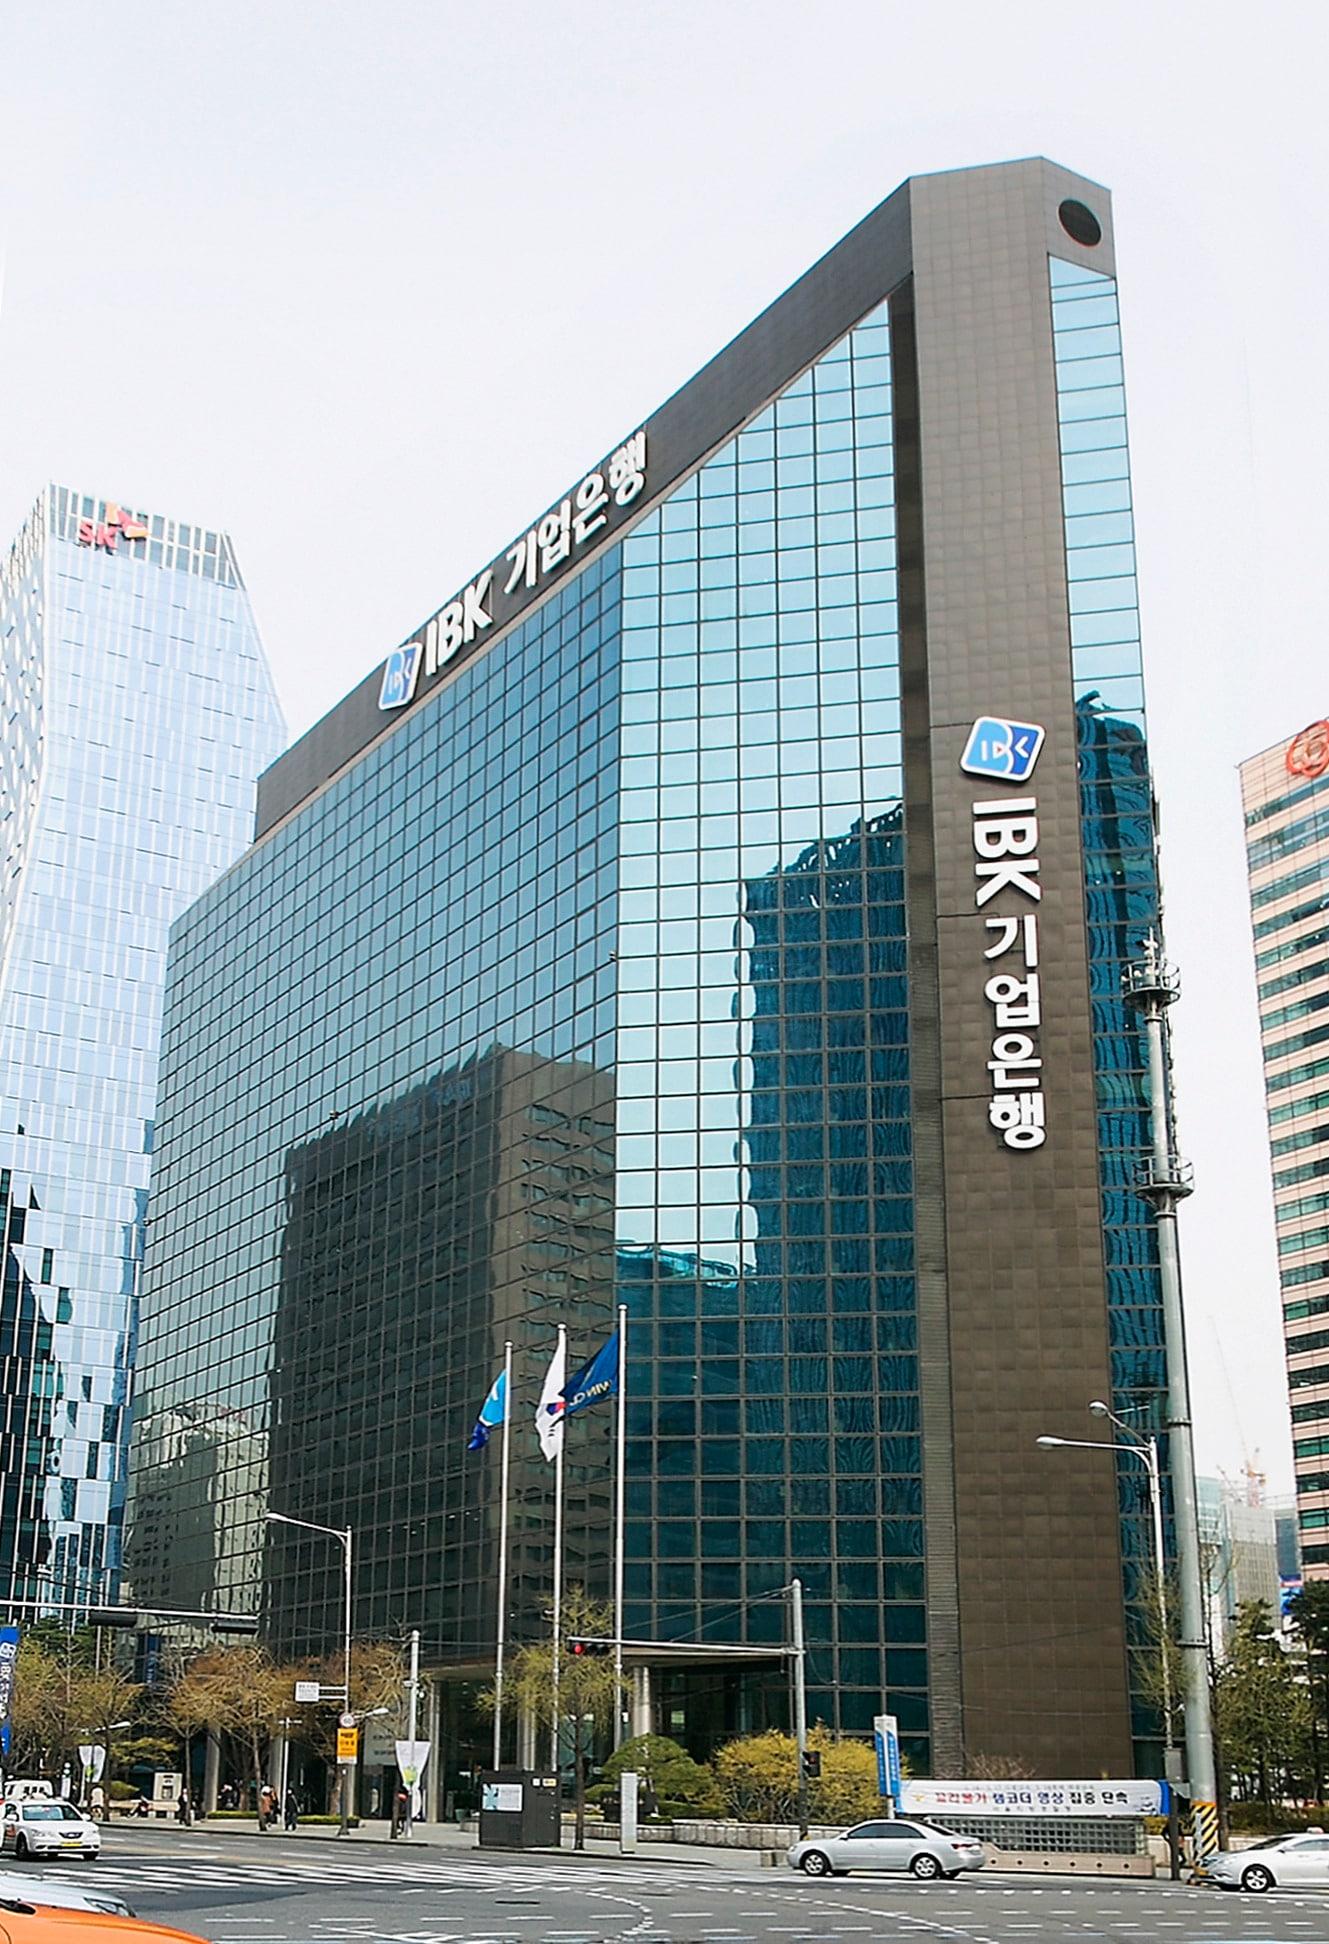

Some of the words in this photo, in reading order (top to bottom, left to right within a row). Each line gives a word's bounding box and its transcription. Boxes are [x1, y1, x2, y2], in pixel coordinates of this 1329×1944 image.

[79, 521, 119, 549] SK
[425, 570, 494, 676] IBK
[504, 431, 647, 594] 기업은행
[973, 797, 1041, 907] IBK
[984, 914, 1046, 1149] 기업은행
[992, 1791, 1032, 1805] 캠코더
[1037, 1791, 1065, 1805] 영상
[1070, 1791, 1096, 1805] 집중
[1101, 1791, 1129, 1805] 단속
